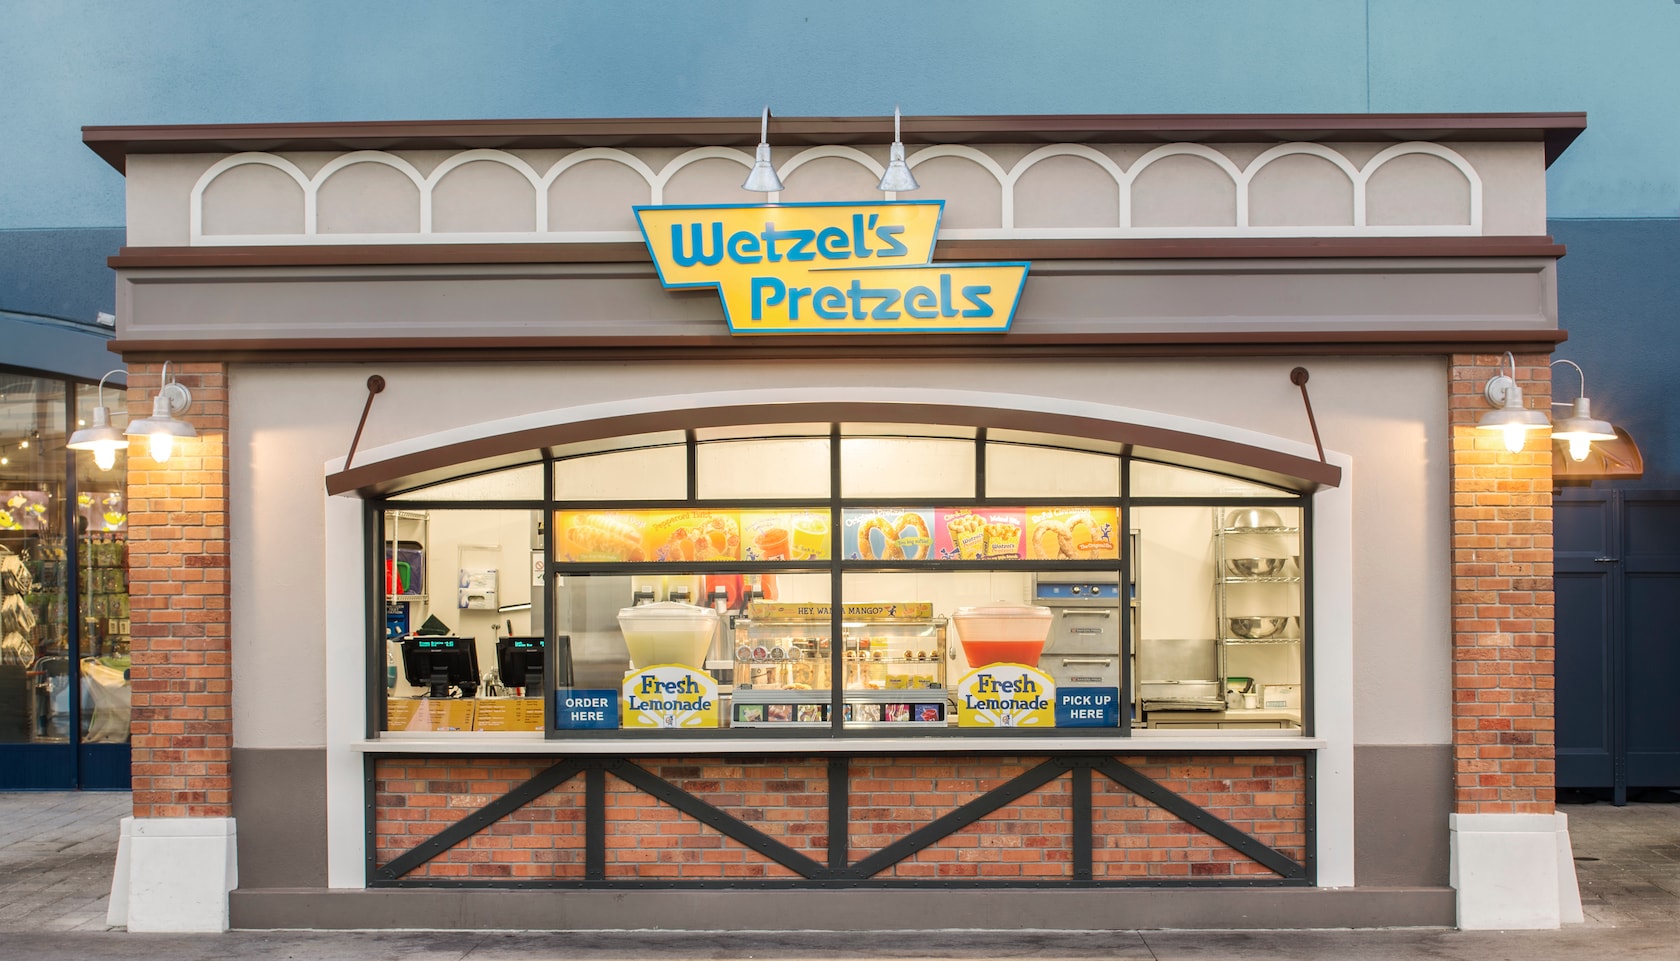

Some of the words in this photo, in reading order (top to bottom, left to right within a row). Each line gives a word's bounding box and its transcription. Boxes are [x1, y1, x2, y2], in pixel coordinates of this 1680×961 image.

[671, 213, 908, 267] Wetzel's
[751, 274, 994, 321] Pretzels
[848, 607, 883, 616] MANGO?
[641, 675, 700, 694] Fresh
[977, 674, 1036, 693] Fresh
[565, 698, 609, 708] ORDER
[629, 695, 711, 711] Lemonade
[965, 694, 1049, 710] Lemonade
[1062, 695, 1091, 705] PICK
[1095, 695, 1112, 705] UP
[571, 711, 604, 721] HERE
[1070, 709, 1104, 719] HERE
